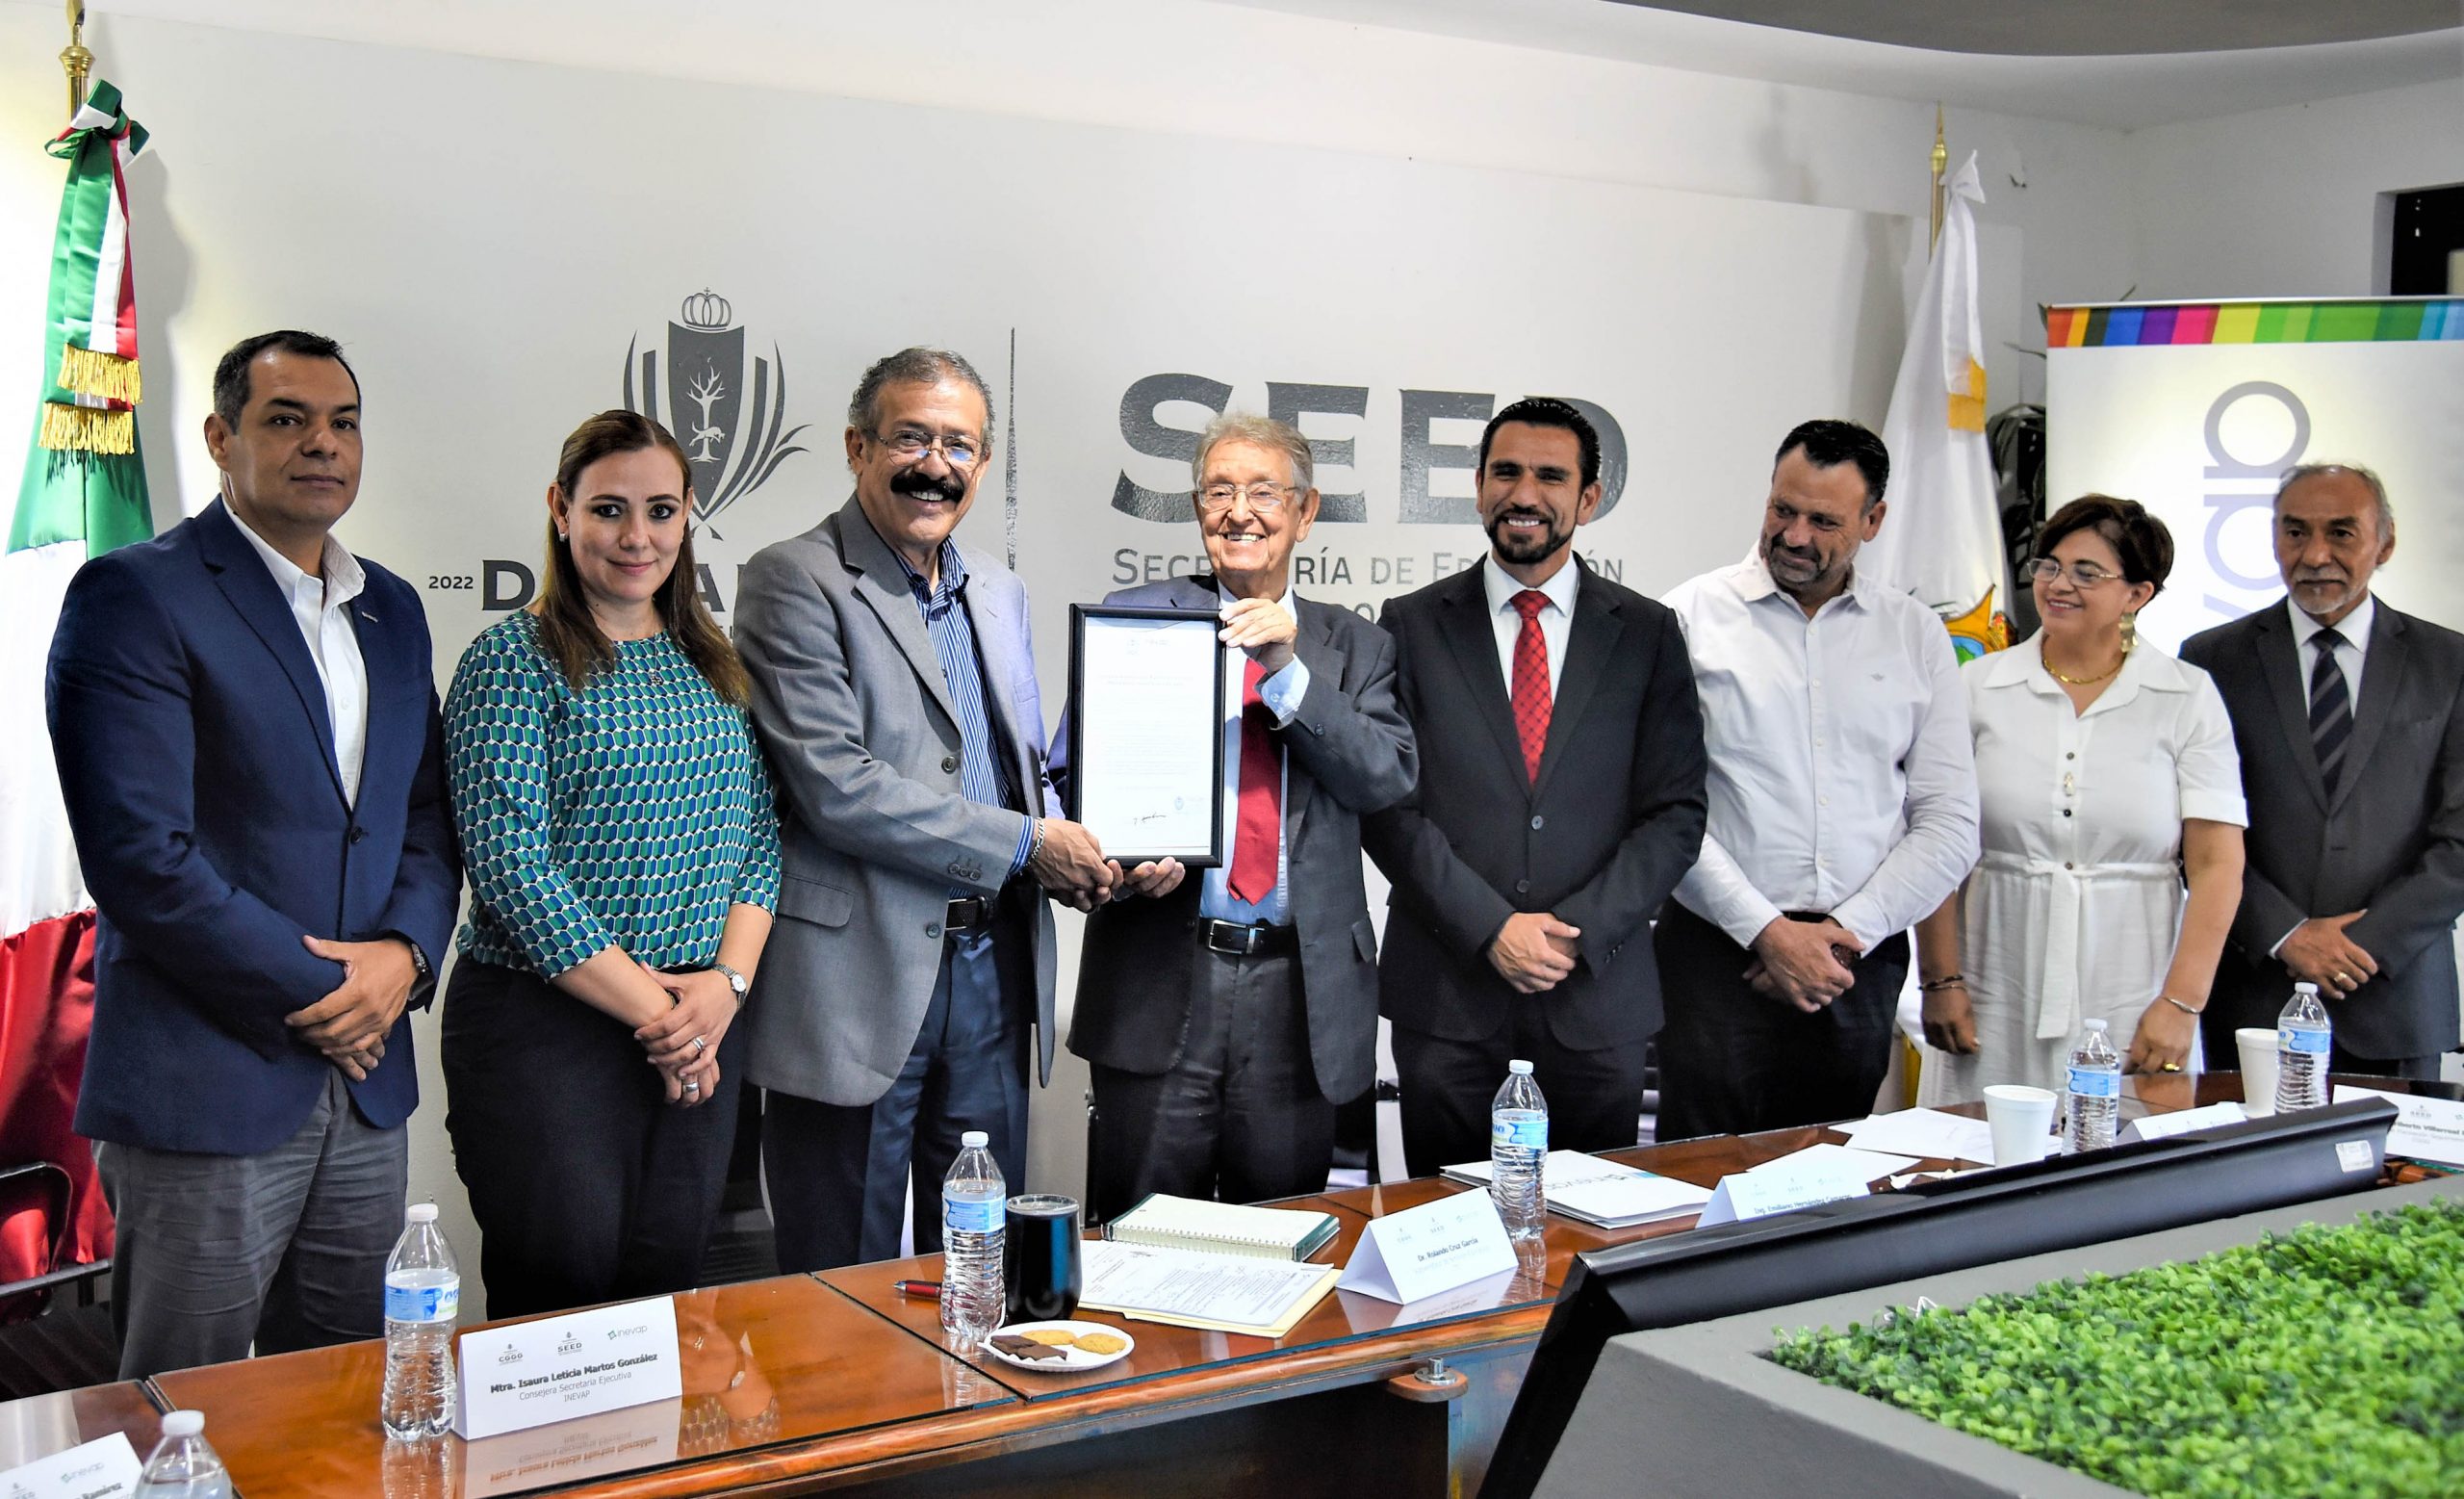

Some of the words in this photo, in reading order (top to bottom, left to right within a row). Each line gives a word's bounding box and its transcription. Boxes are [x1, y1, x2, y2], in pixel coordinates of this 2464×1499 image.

[1111, 373, 1628, 525] SEE
[1371, 556, 1414, 584] DE
[428, 576, 474, 590] 2022
[618, 1325, 649, 1337] inevap
[557, 1342, 582, 1353] SEED
[490, 1383, 516, 1394] Mtra.
[518, 1376, 550, 1388] Isaura
[552, 1368, 582, 1382] Leticia
[583, 1362, 616, 1375] Martos
[617, 1353, 658, 1368] González
[519, 1386, 557, 1401] Consejera
[599, 1372, 632, 1385] Ejecutiva
[564, 1389, 591, 1403] INEVAP
